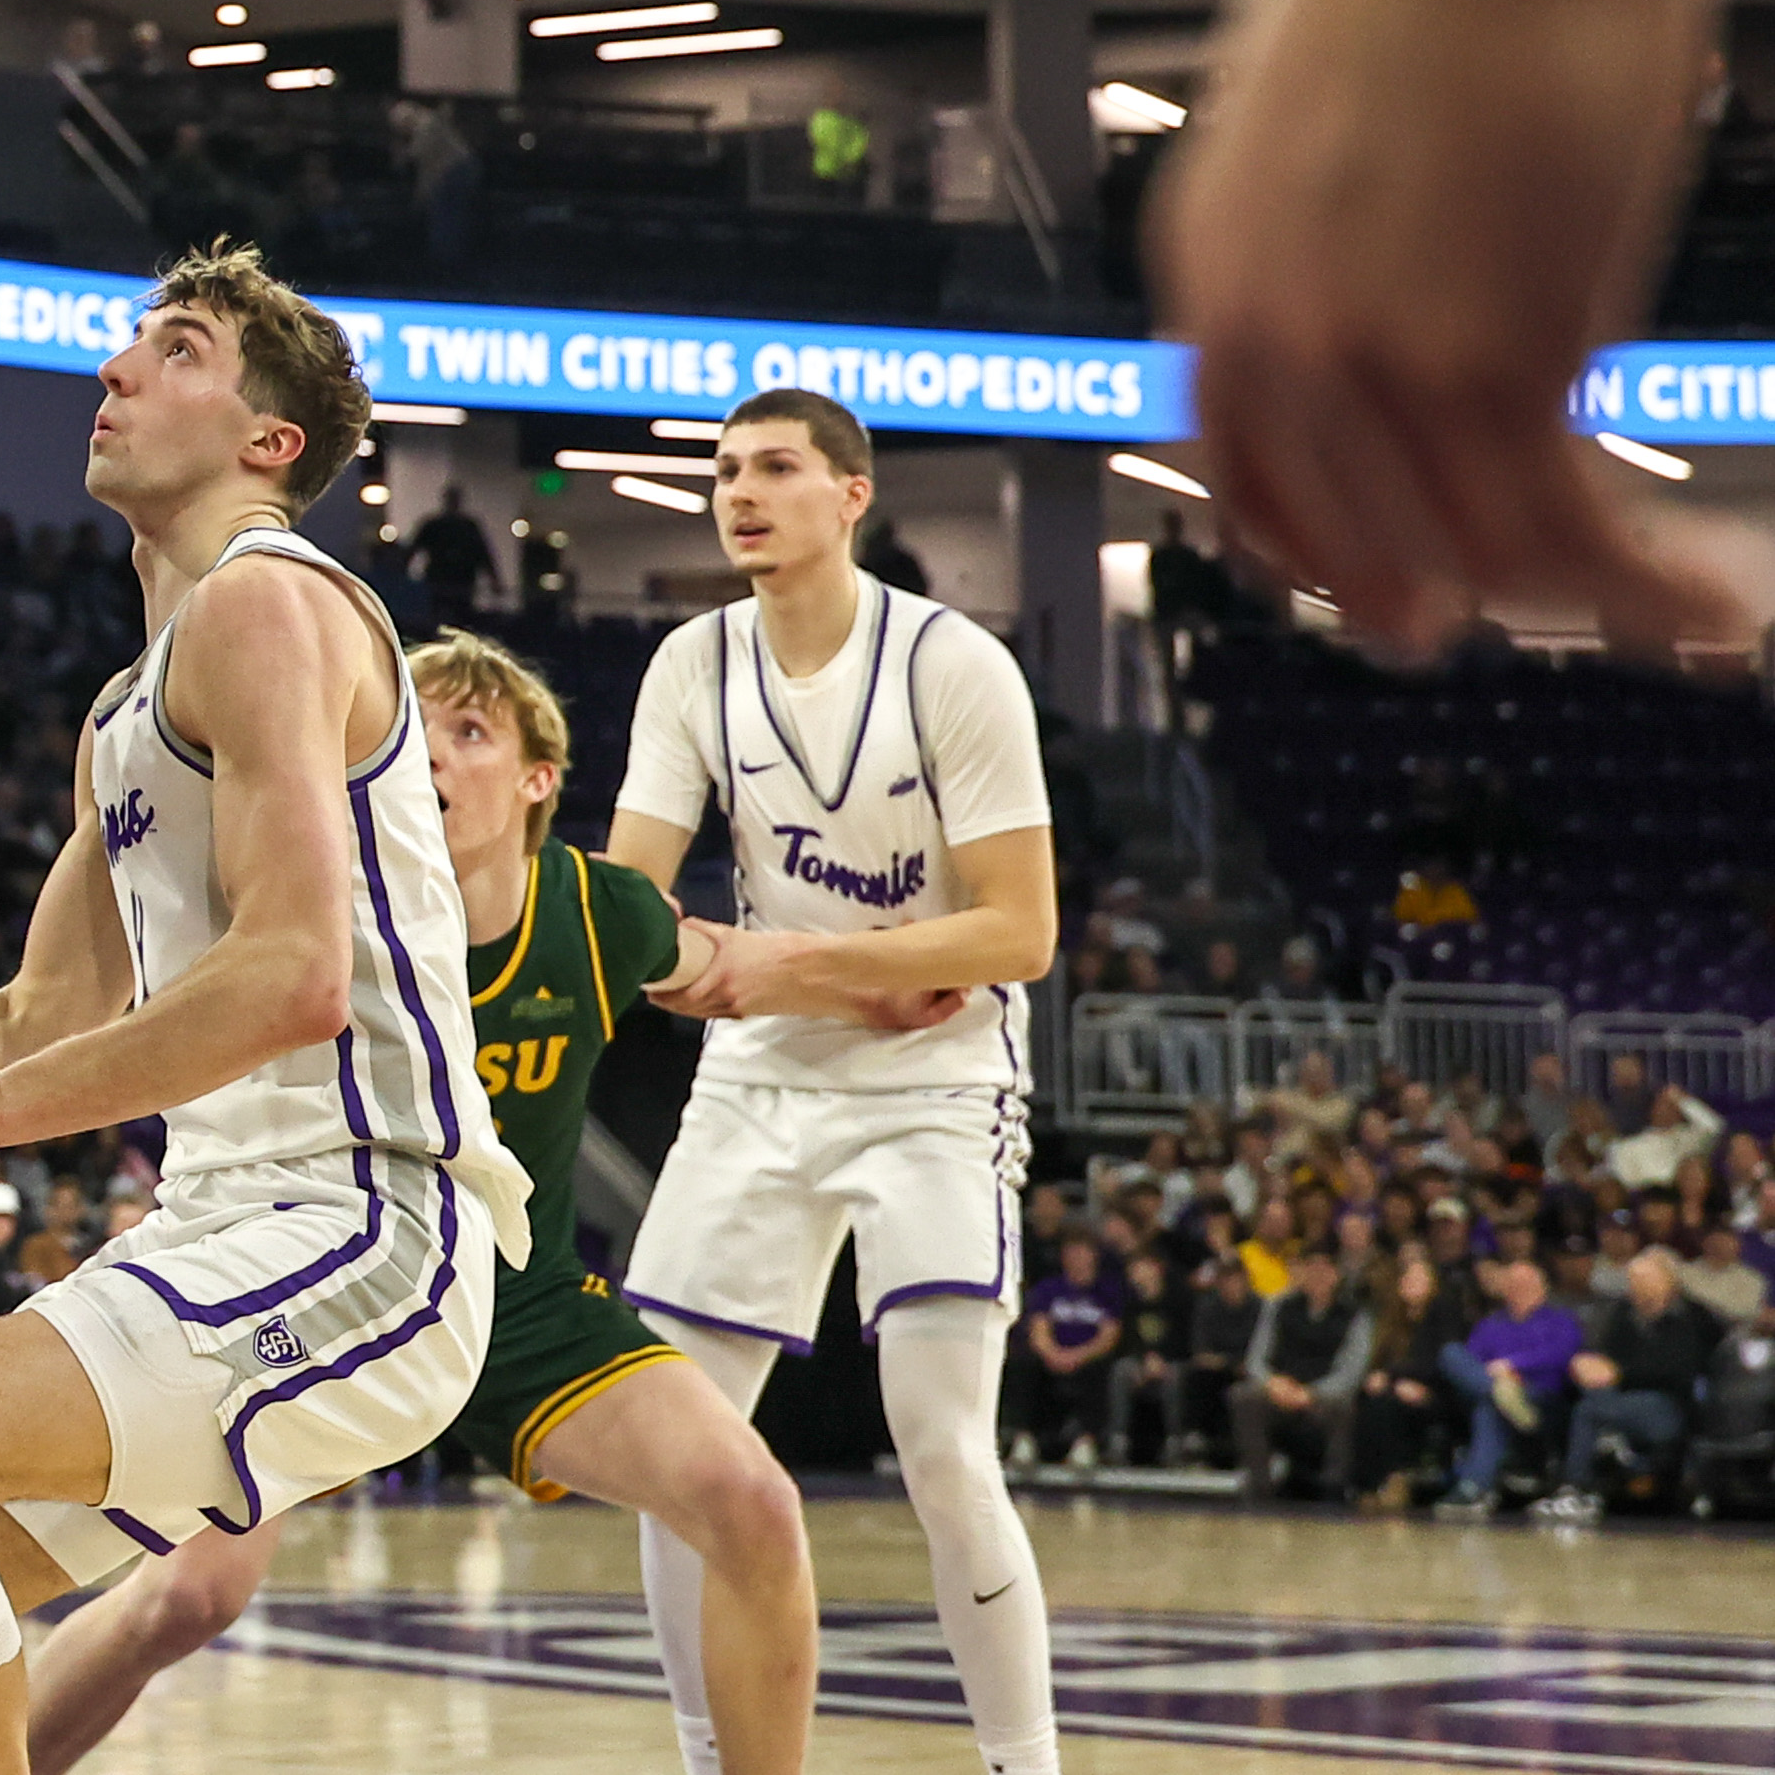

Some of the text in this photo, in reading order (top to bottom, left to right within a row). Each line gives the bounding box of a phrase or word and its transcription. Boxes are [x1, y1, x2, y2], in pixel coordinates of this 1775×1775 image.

[400, 324, 1142, 418] TWIN CITIES ORTHOPEDICS
